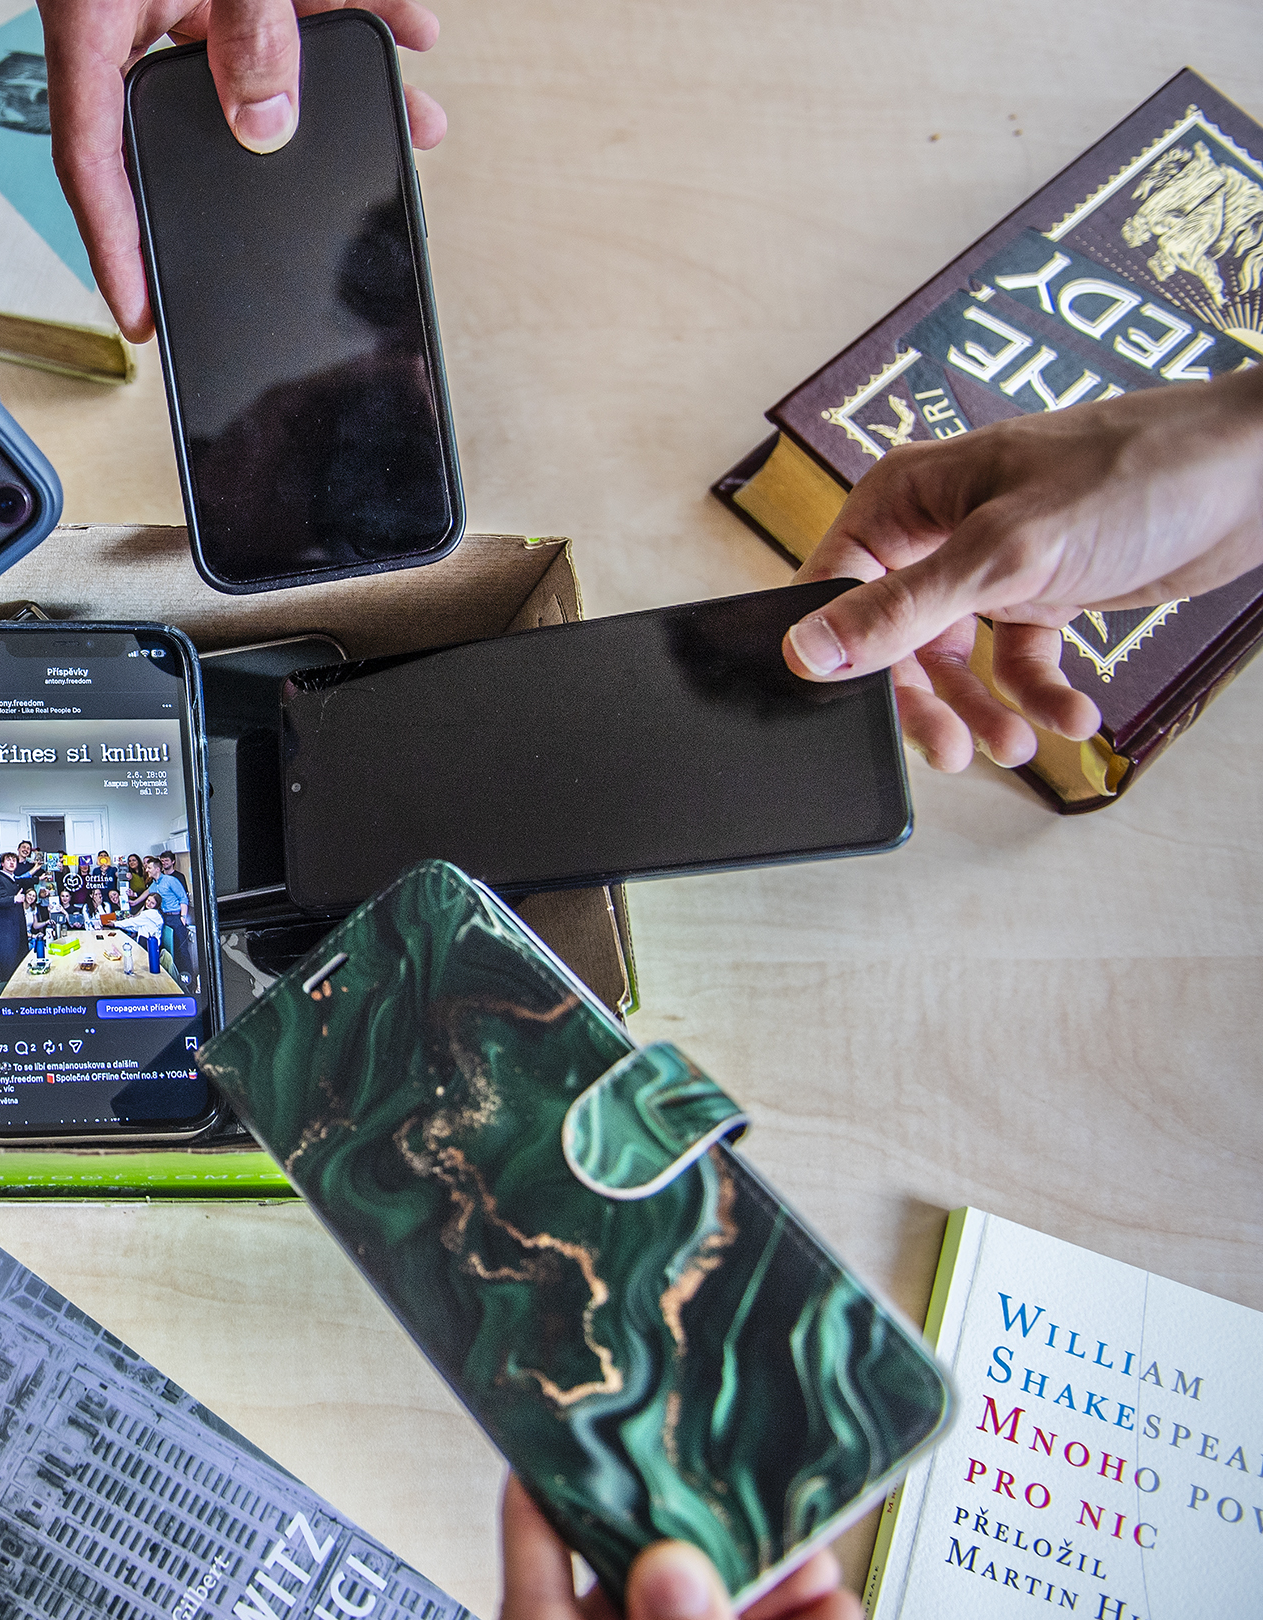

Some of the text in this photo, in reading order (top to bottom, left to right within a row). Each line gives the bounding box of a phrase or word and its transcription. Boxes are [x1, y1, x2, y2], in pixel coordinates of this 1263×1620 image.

[46, 667, 89, 677] Příspěvky
[50, 707, 71, 715] People
[66, 744, 92, 763] si
[100, 743, 170, 763] knihu!
[126, 771, 143, 779] 2.6.
[103, 780, 129, 789] Kampus
[154, 787, 168, 795] D.2
[1, 1006, 14, 1015] tis.
[20, 1006, 52, 1015] Zobrazit
[53, 1005, 87, 1015] přehledy
[106, 1003, 187, 1013] Propagovat příspěvek
[30, 1043, 37, 1052] 2
[57, 1042, 63, 1051] 1
[13, 1063, 23, 1071] To
[47, 1061, 105, 1072] emajanouskova
[113, 1060, 139, 1069] dalším
[56, 1073, 90, 1083] Společné
[91, 1072, 119, 1081] OFFline
[120, 1070, 140, 1080] Čtení
[141, 1071, 157, 1080] no.8
[165, 1070, 188, 1079] YOGA
[997, 1291, 1206, 1402] WILLIAM
[975, 1394, 1161, 1494] MNOHO
[963, 1456, 1159, 1550] PRO NIC
[953, 1505, 1108, 1581] PŘELOŽIL
[944, 1536, 1080, 1612] MARTIN
[172, 1554, 231, 1620] Gilbert
